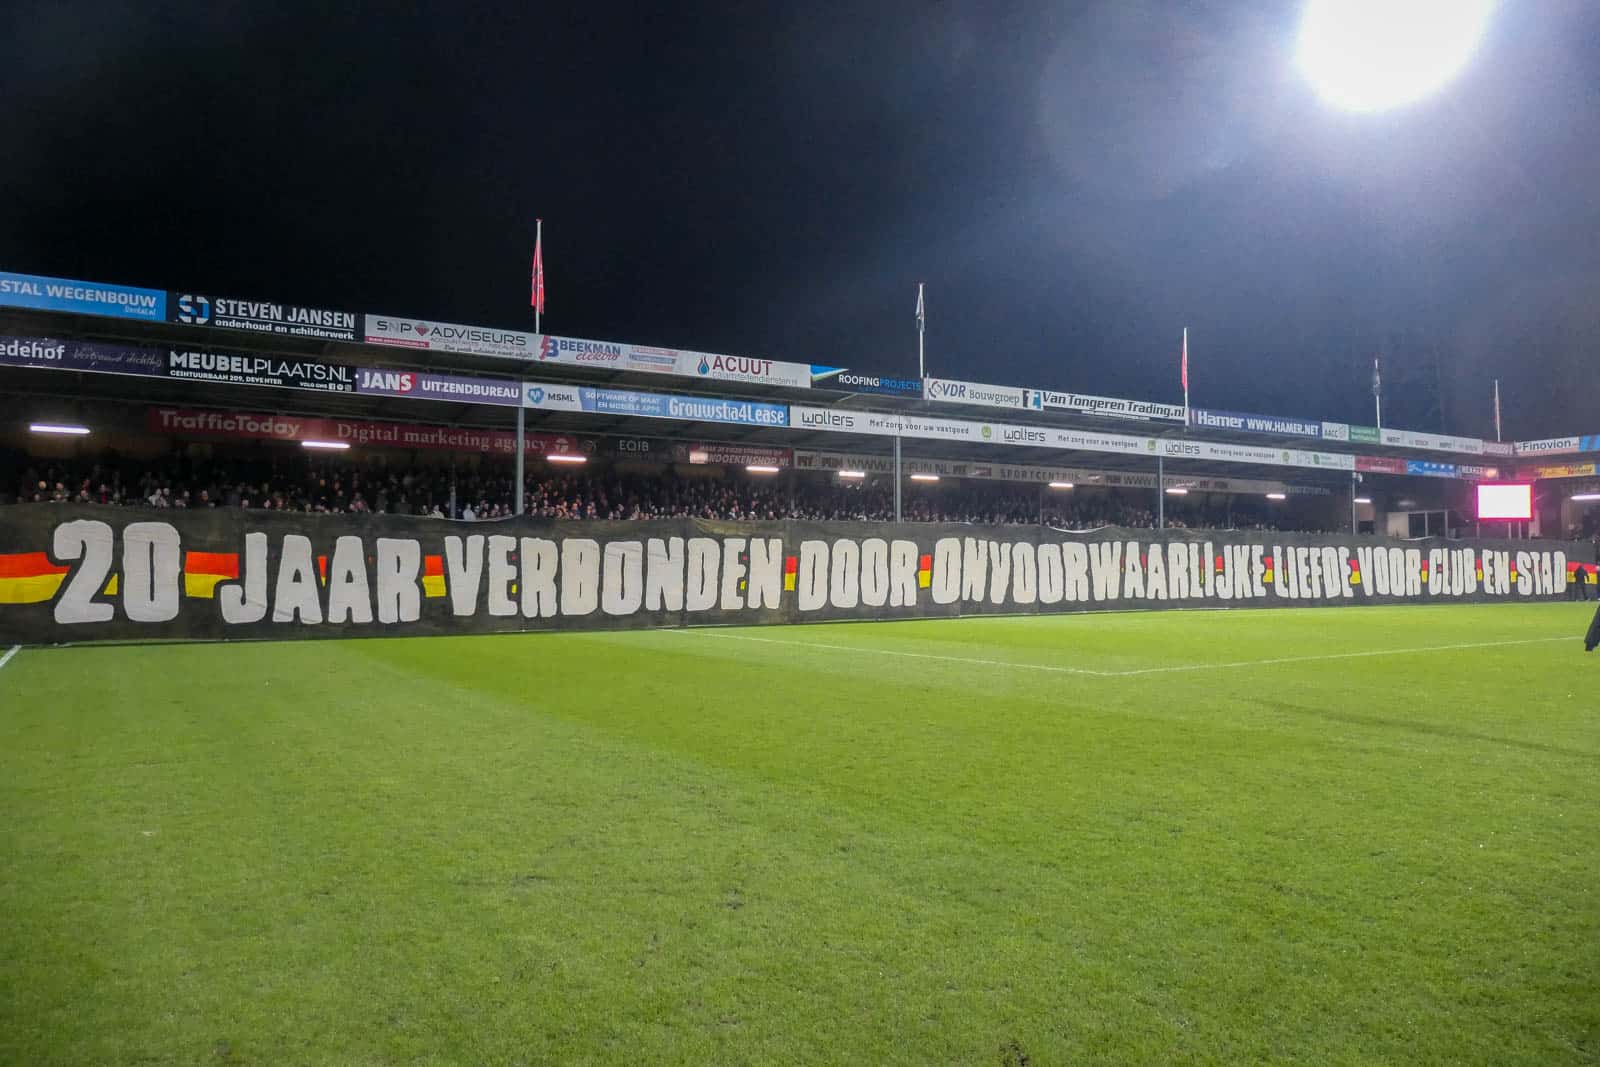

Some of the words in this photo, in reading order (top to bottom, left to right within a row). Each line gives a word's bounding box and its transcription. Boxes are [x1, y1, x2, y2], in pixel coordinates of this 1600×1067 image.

[47, 285, 156, 308] WEGENBOUW
[215, 298, 282, 321] STEVEN
[287, 307, 355, 329] JANSEN
[215, 319, 272, 332] onderhoud
[274, 325, 287, 334] en
[290, 326, 354, 341] schilderwerk
[377, 320, 412, 334] SNP
[430, 326, 527, 347] ADVISEURS
[559, 339, 621, 356] BEEKMAN
[575, 351, 620, 362] elektro
[169, 351, 353, 383] MEUBELPLAATS.NL
[712, 355, 773, 376] ACUUT
[362, 371, 411, 392] JANS
[422, 380, 519, 399] UITZENDBUREAU
[942, 383, 966, 399] VDR
[969, 389, 1020, 406] Bouwgroep
[547, 393, 575, 402] MSML
[1043, 391, 1066, 404] Van
[1069, 395, 1125, 410] Tongeren
[1128, 401, 1185, 418] Trading.nl
[160, 410, 300, 437] TrafficToday
[802, 409, 855, 427] wolters
[1197, 410, 1244, 428] Hamer
[1247, 417, 1320, 437] WWW.HAMER.NET
[337, 422, 398, 442] Digital
[404, 430, 489, 450] marketing
[1003, 427, 1046, 442] wolters
[1522, 438, 1571, 451] Finovion
[1165, 441, 1200, 454] wolters
[53, 519, 182, 624] 20
[220, 532, 421, 625] JAAR
[444, 534, 783, 618] VERBONDEN
[798, 538, 918, 611] DOOR
[932, 537, 1267, 604] ONVOORWAARLIJKE
[1273, 544, 1353, 599] LIEFDE
[1357, 546, 1422, 597] VOOR
[1428, 548, 1477, 596] CLUB
[1482, 549, 1510, 595] EN
[1516, 550, 1567, 595] STAD
